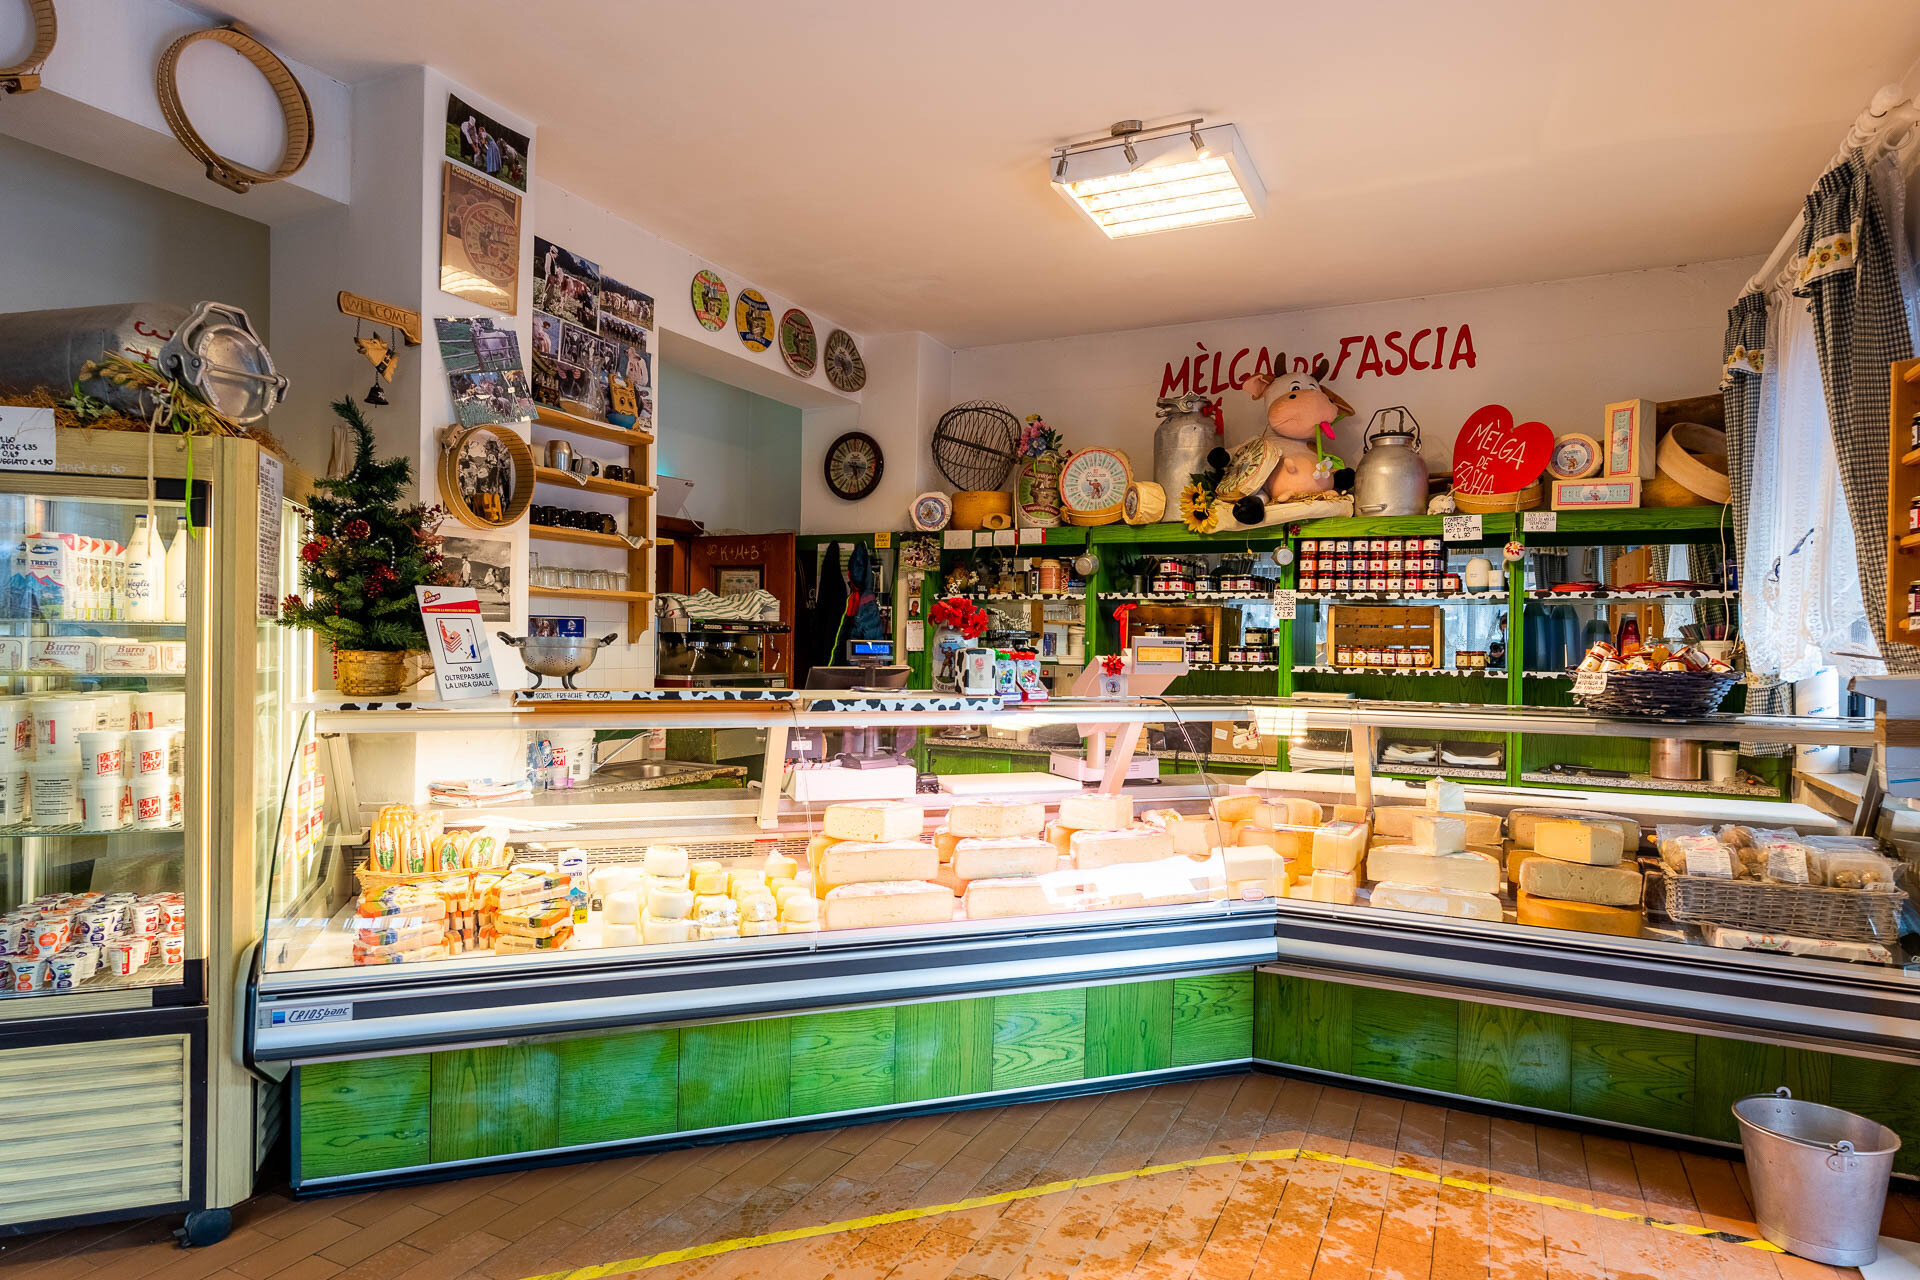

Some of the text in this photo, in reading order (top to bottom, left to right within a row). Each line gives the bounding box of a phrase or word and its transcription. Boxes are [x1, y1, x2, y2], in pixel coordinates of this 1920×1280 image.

[452, 166, 488, 186] FORMAGGI
[347, 297, 408, 324] WELCOME
[1160, 342, 1275, 399] MÈLGA
[1329, 324, 1476, 381] FASCIA
[1467, 419, 1526, 471] MÈLGA
[1476, 456, 1493, 470] DE
[30, 559, 58, 567] TRENTO
[45, 641, 81, 651] Burro
[117, 645, 146, 653] Burro
[445, 673, 491, 681] OLTREPASSARE
[455, 681, 472, 689] LINEA
[473, 680, 494, 688] GIALLA
[100, 752, 111, 762] VAL
[143, 752, 154, 761] VAL
[100, 761, 120, 771] FASSA
[143, 761, 161, 771] FASSA
[140, 799, 150, 809] VAL
[140, 806, 159, 817] FASSA
